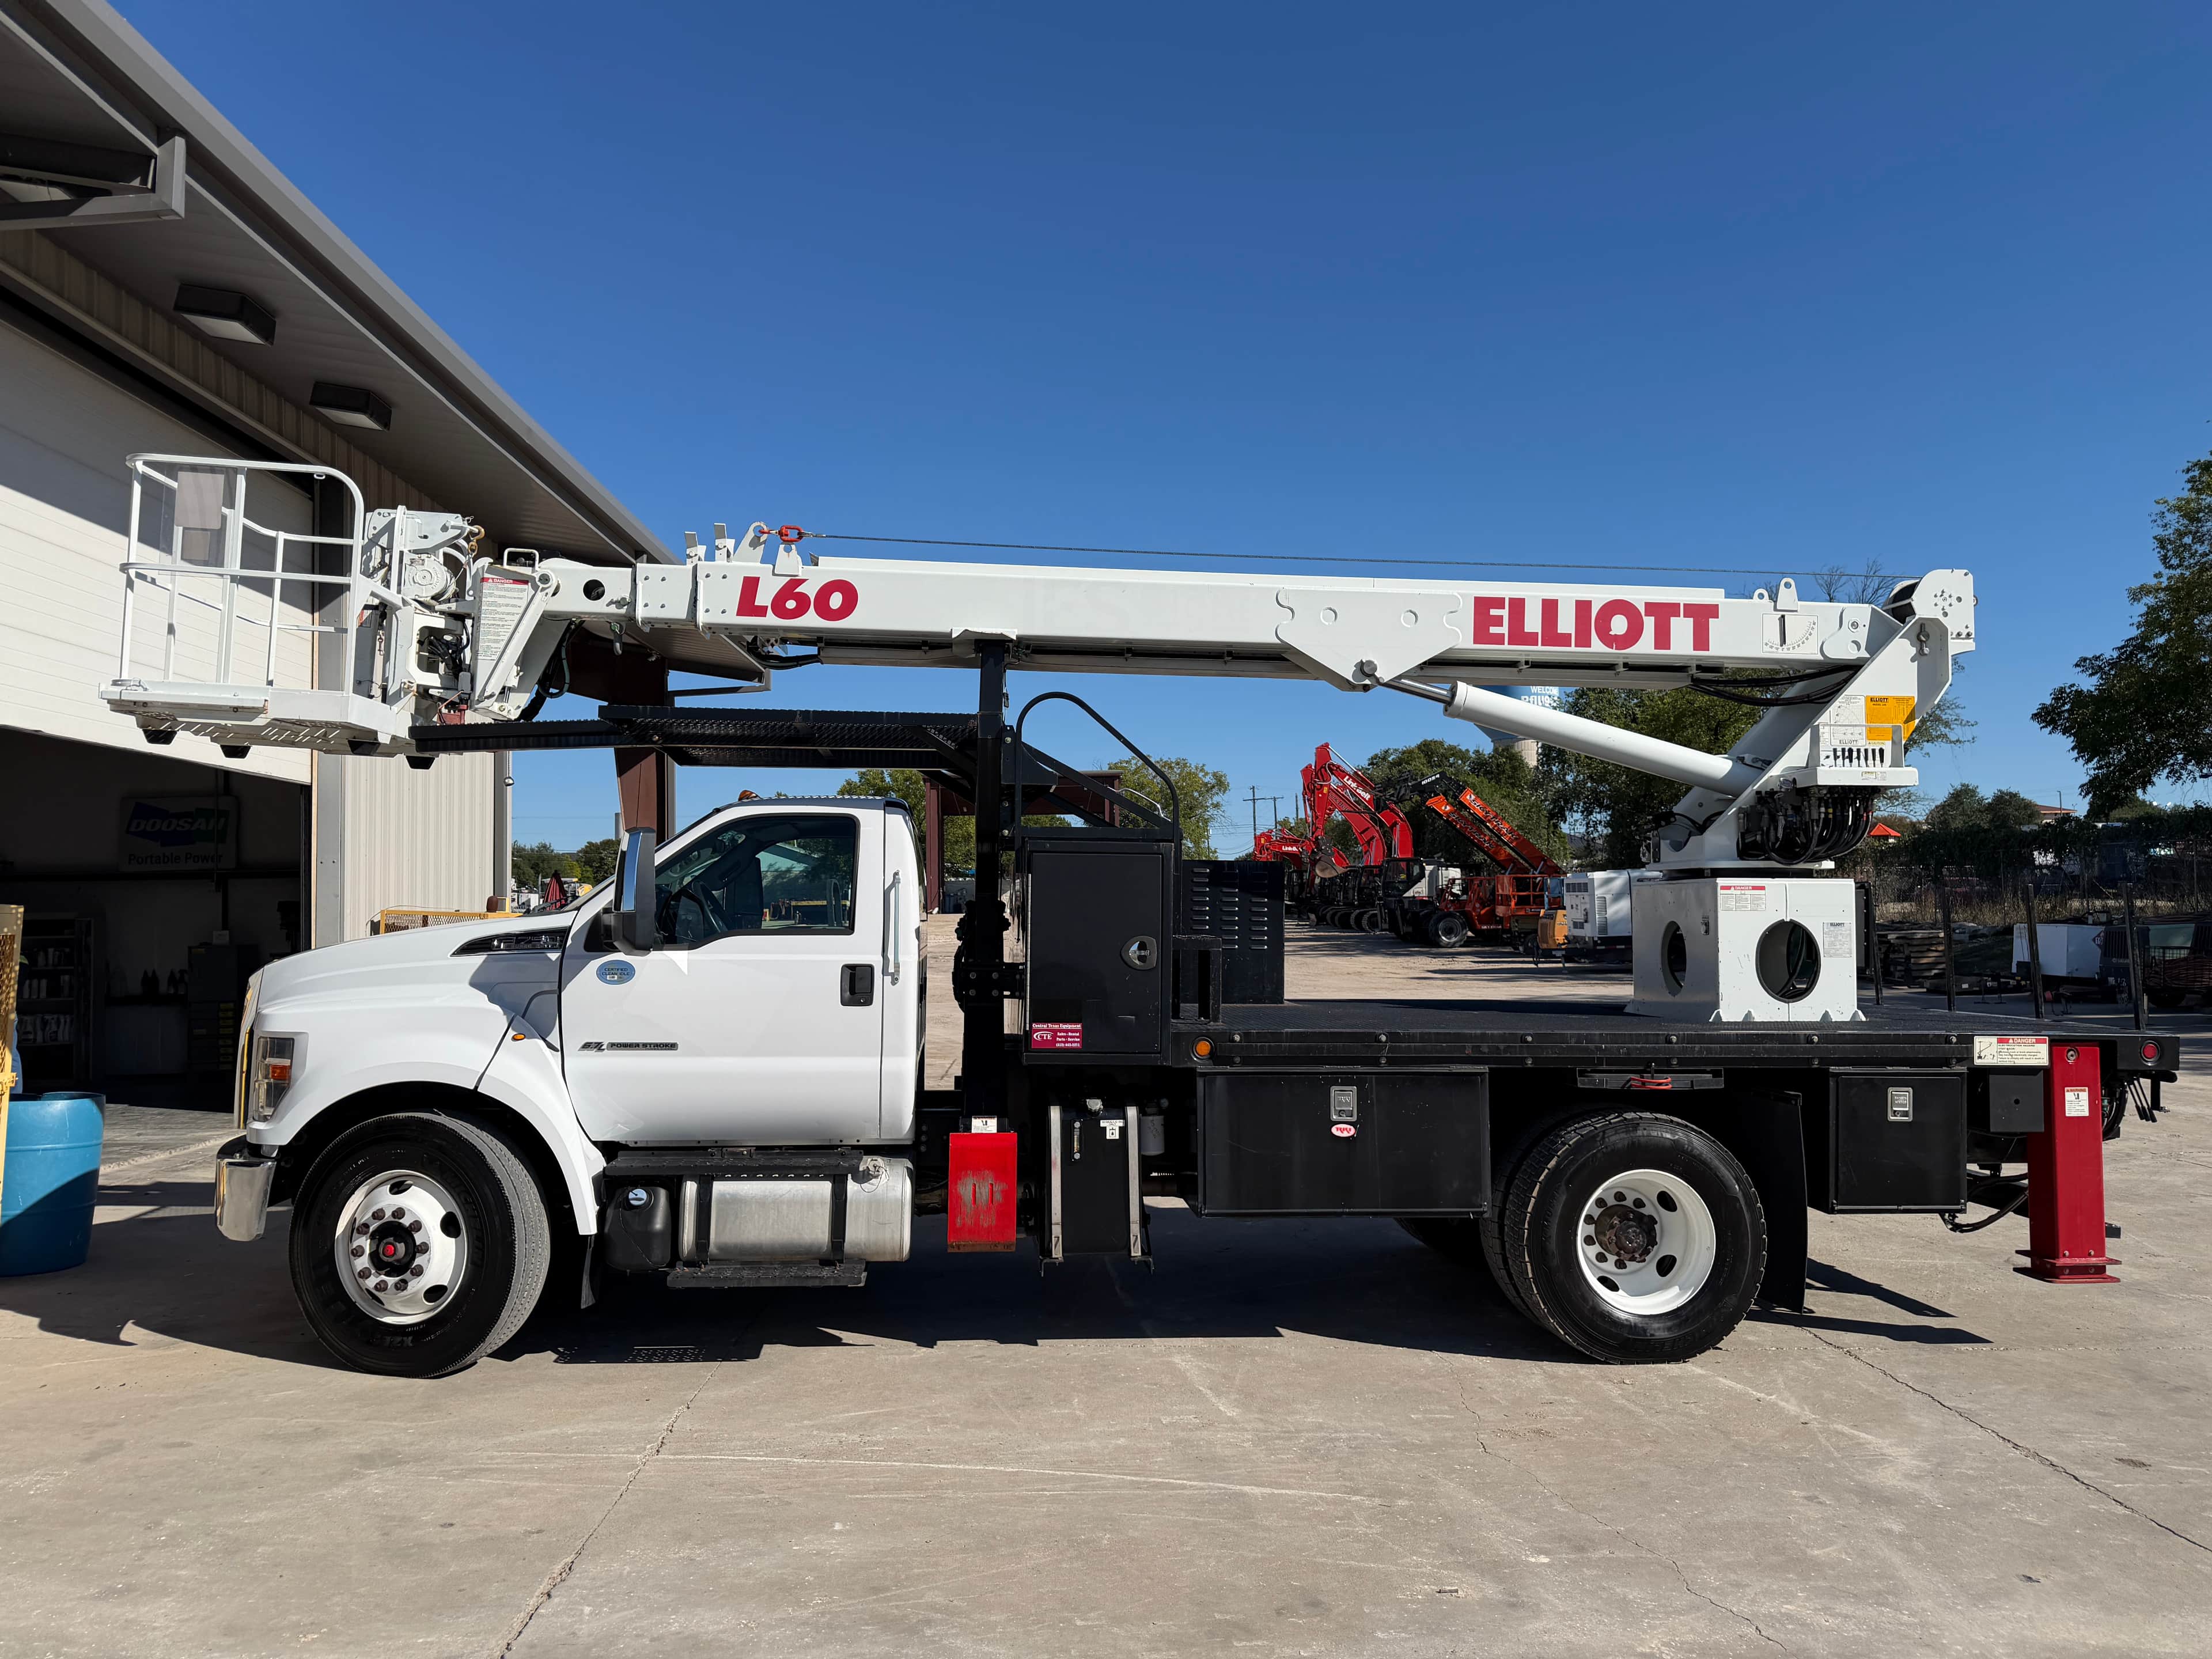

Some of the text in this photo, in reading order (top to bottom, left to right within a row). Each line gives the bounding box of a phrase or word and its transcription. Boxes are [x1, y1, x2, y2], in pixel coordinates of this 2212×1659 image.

[736, 576, 858, 622] L60
[1473, 596, 1719, 652] ELLIOTT
[129, 817, 226, 831] DOOSAN
[1470, 798, 1519, 840] SKYTRAK
[128, 852, 223, 865] Portable Power
